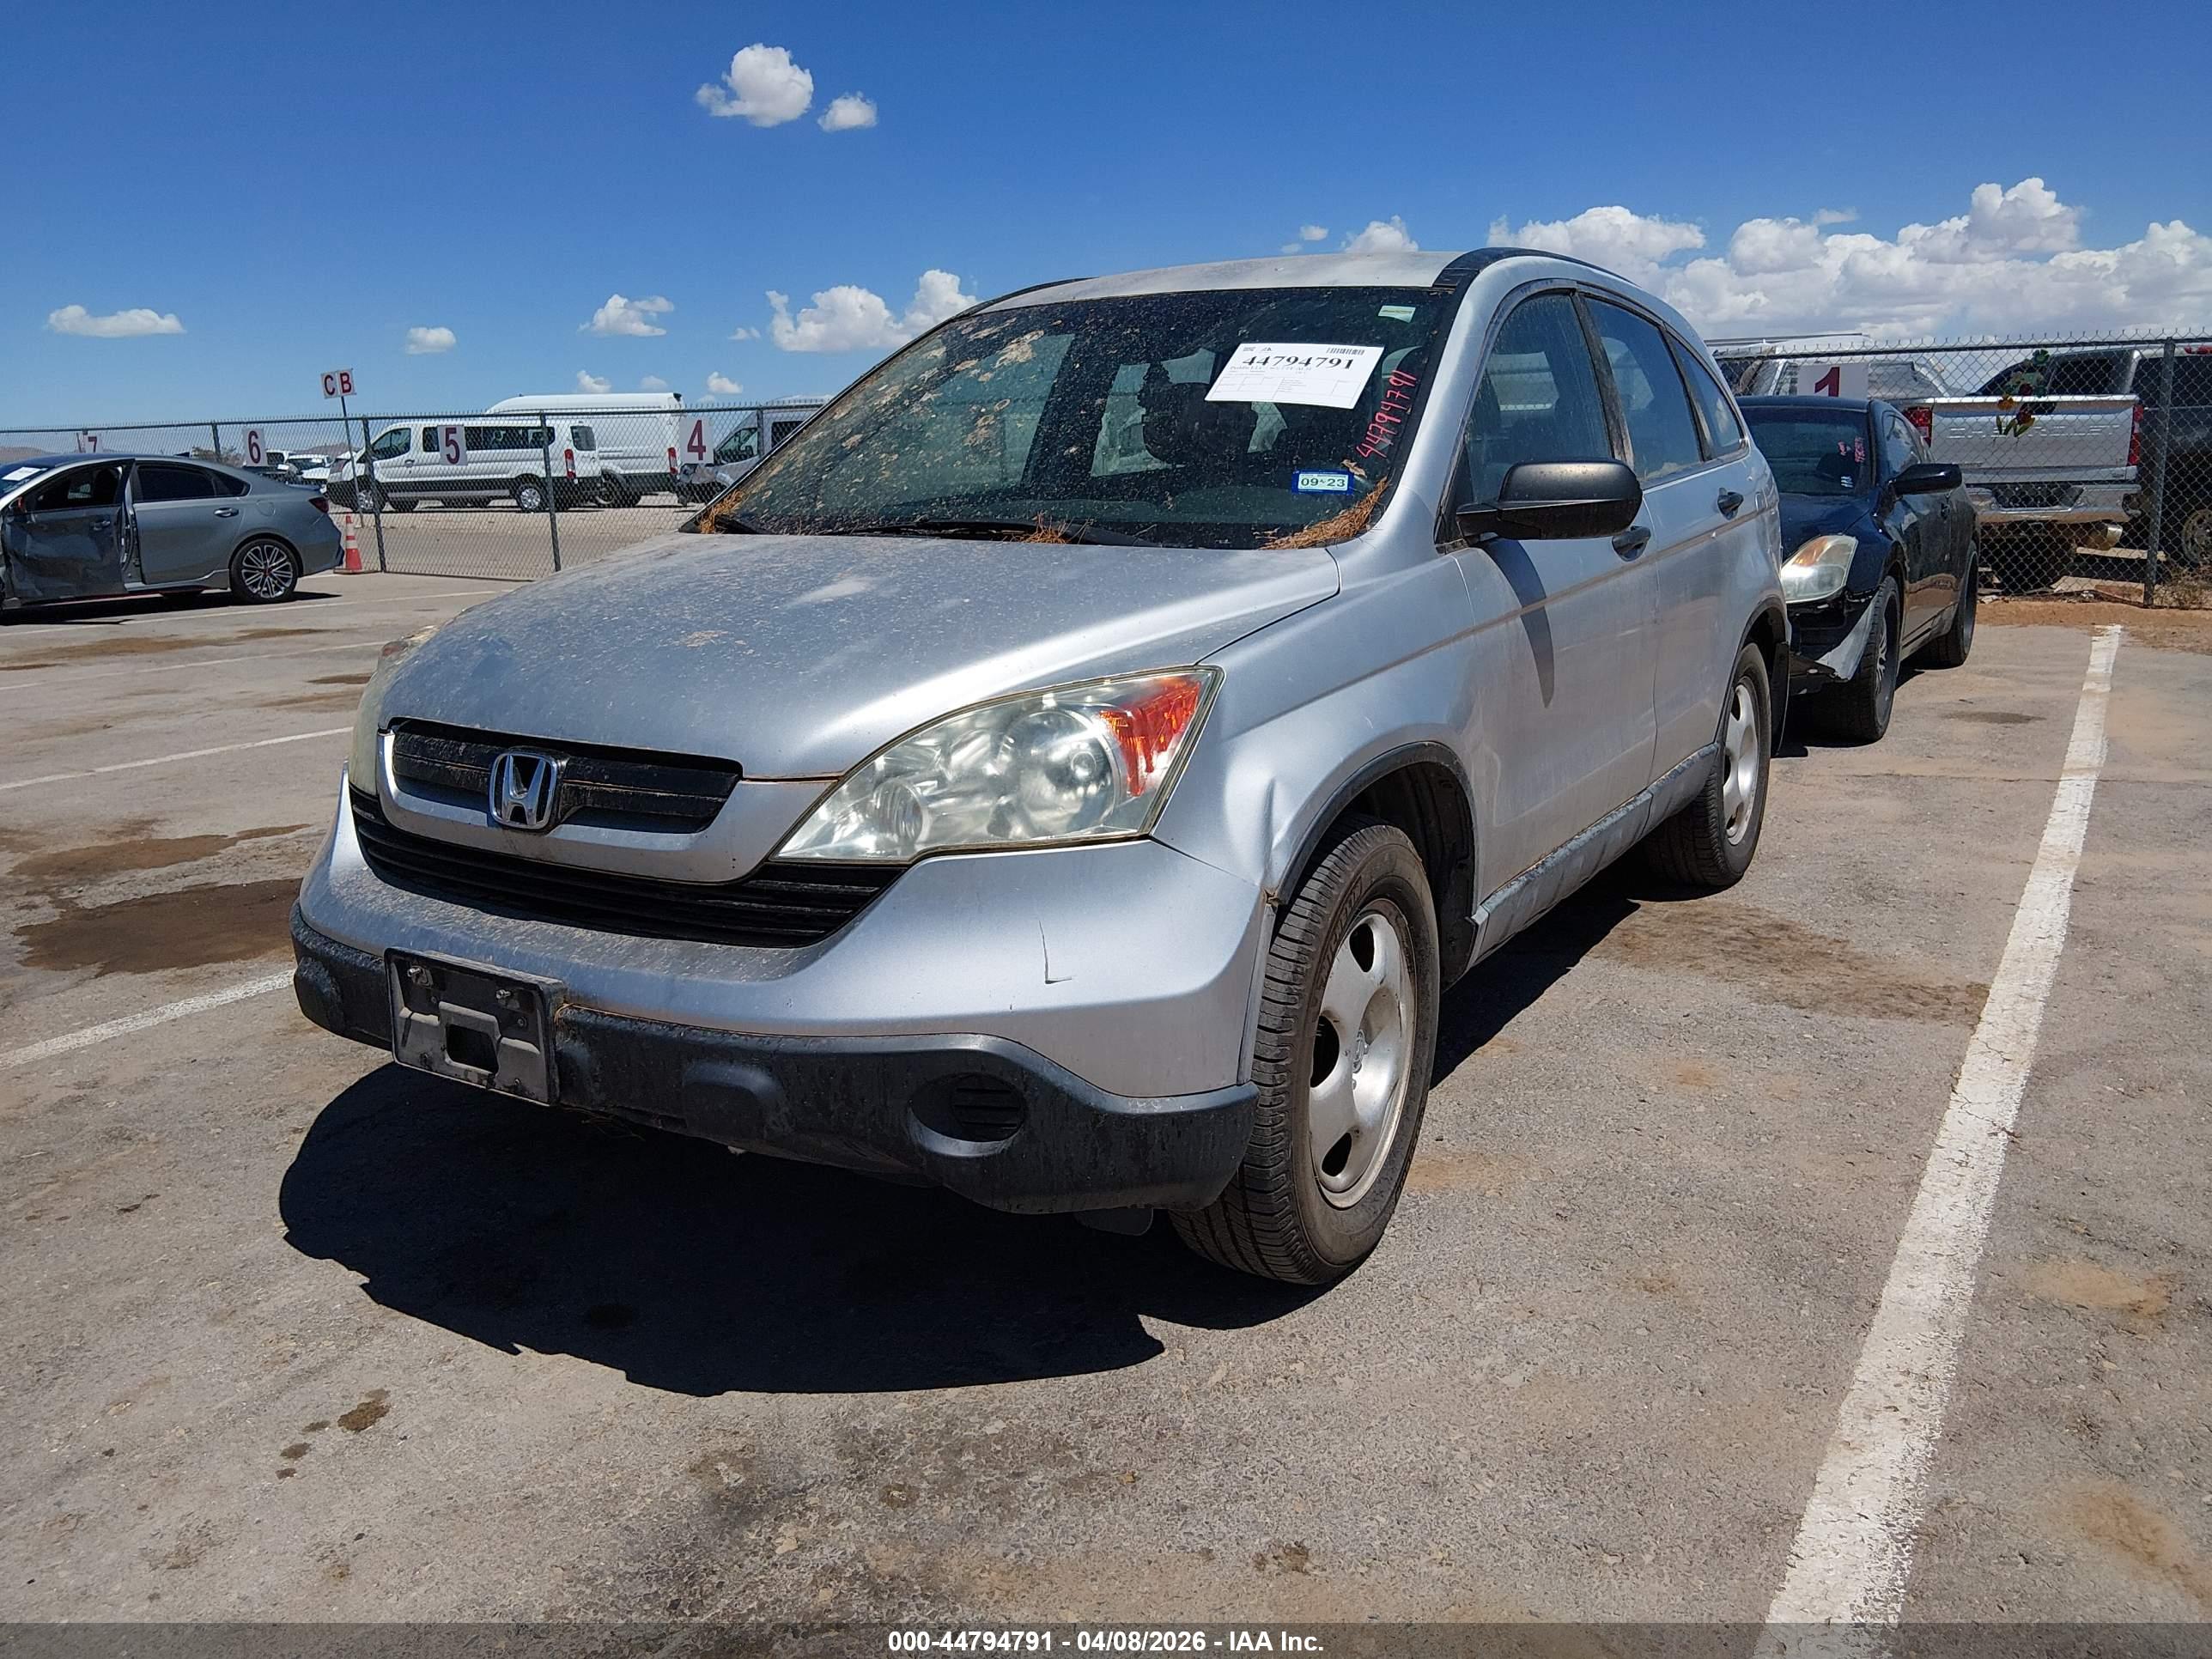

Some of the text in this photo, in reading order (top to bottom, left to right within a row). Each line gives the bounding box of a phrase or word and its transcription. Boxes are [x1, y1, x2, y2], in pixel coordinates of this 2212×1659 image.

[1243, 356, 1353, 369] 44794791
[1814, 367, 1840, 397] 1
[1356, 370, 1417, 458] 44794791
[88, 436, 97, 453] 7
[248, 430, 261, 464] 6
[445, 427, 459, 465] 5
[687, 419, 707, 461] 4
[1301, 477, 1346, 487] 09 23
